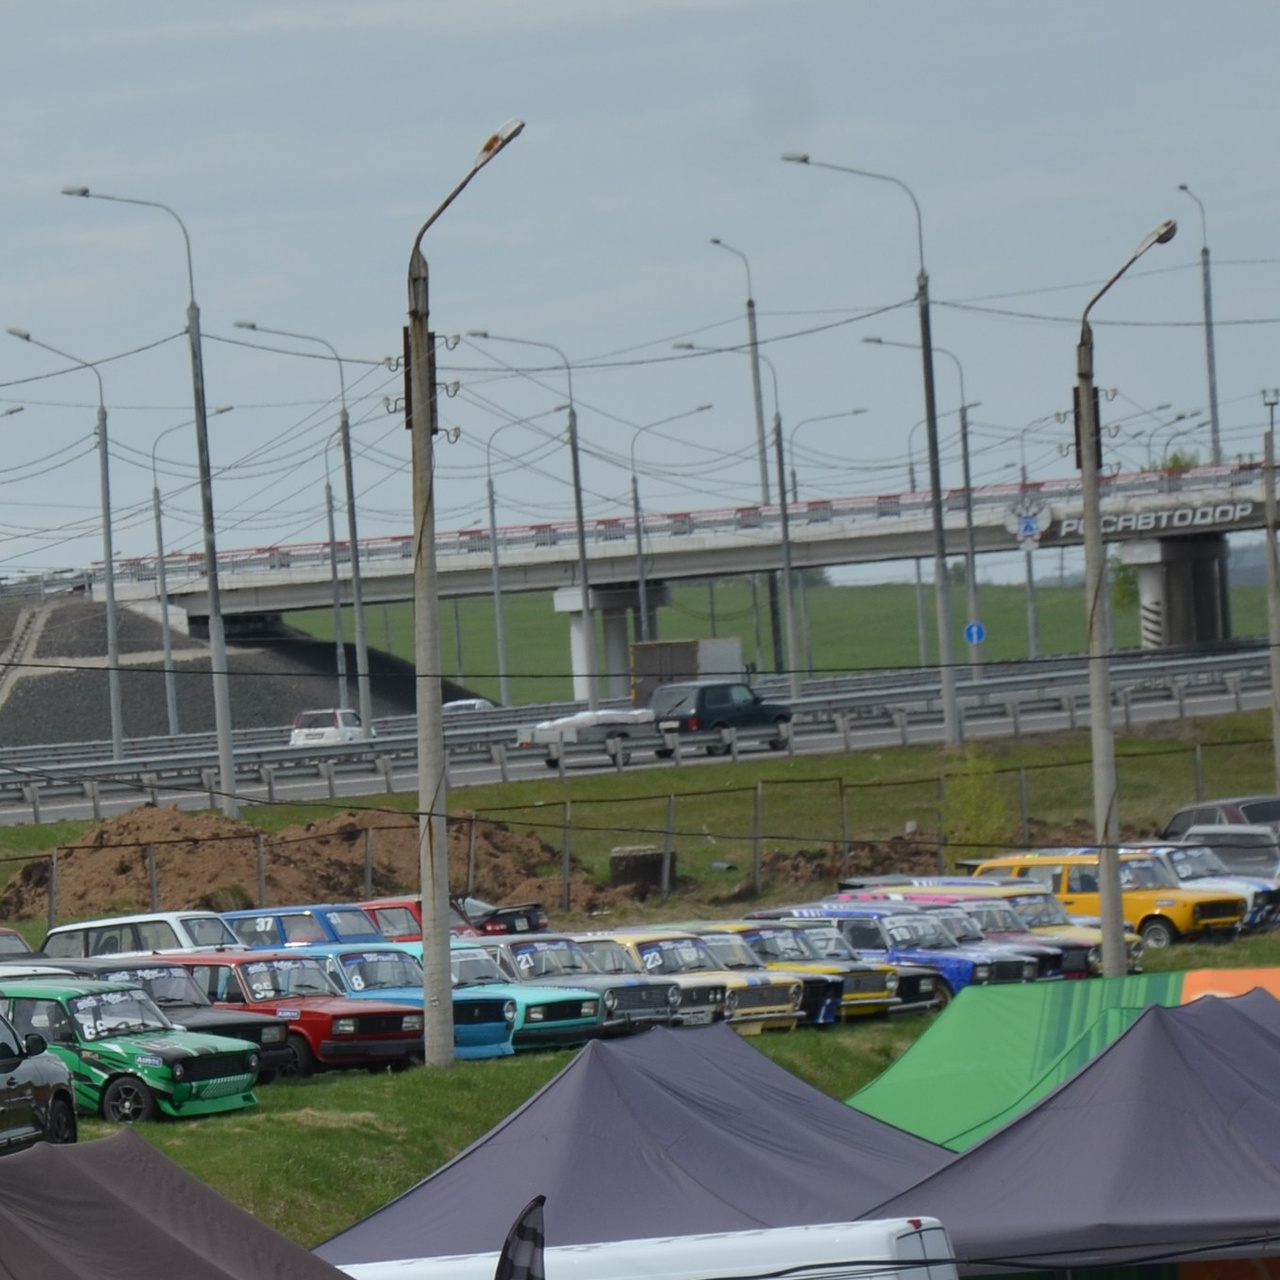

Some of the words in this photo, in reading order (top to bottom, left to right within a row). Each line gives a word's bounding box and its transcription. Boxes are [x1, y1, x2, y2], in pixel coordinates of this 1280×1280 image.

[1060, 503, 1252, 537] РСАВТОДОР
[255, 917, 273, 932] 37
[516, 951, 535, 970] 21
[643, 952, 663, 969] 23
[351, 975, 365, 991] 8
